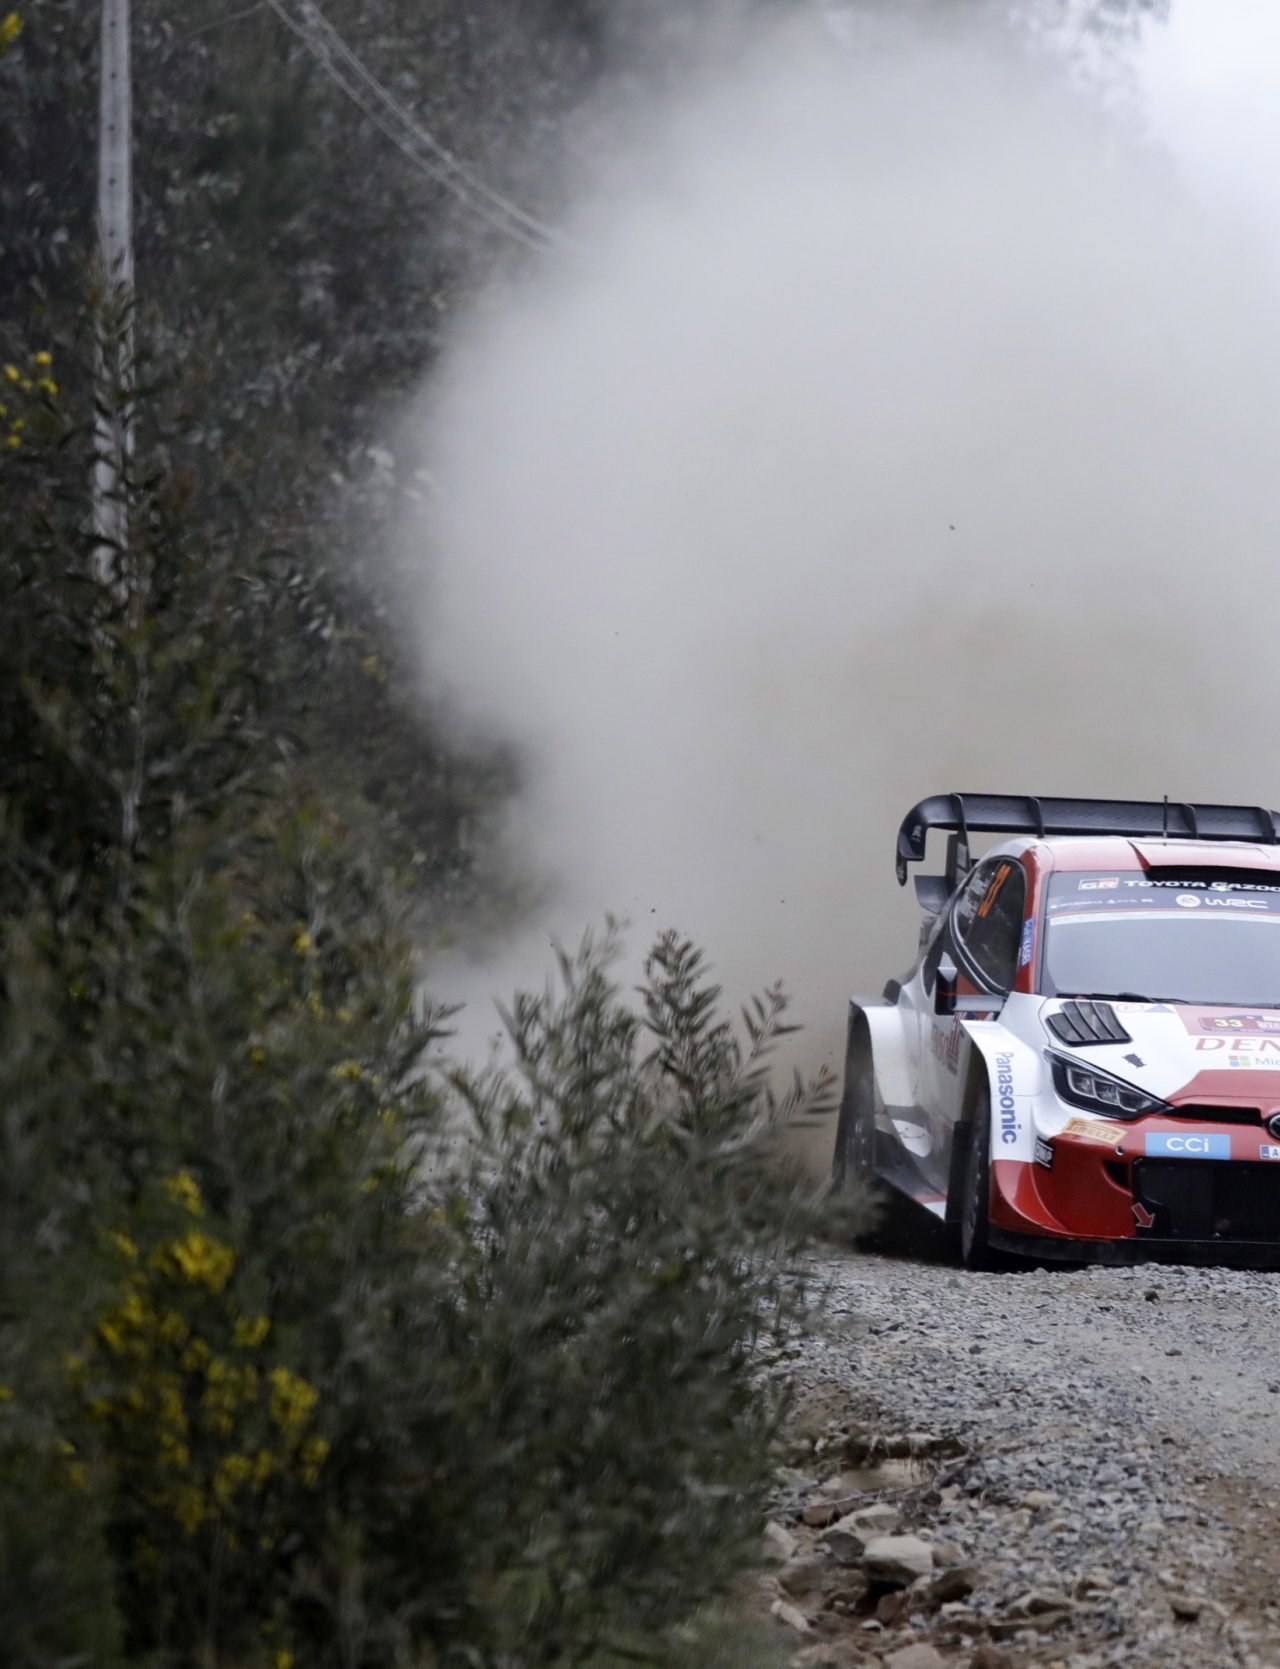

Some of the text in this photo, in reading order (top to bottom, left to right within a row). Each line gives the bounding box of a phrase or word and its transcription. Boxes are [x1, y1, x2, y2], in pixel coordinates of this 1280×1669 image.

[1123, 880, 1207, 888] TOYOTA
[1204, 897, 1270, 909] WRC
[1214, 1018, 1243, 1028] 33
[994, 1051, 1022, 1145] Panasonic
